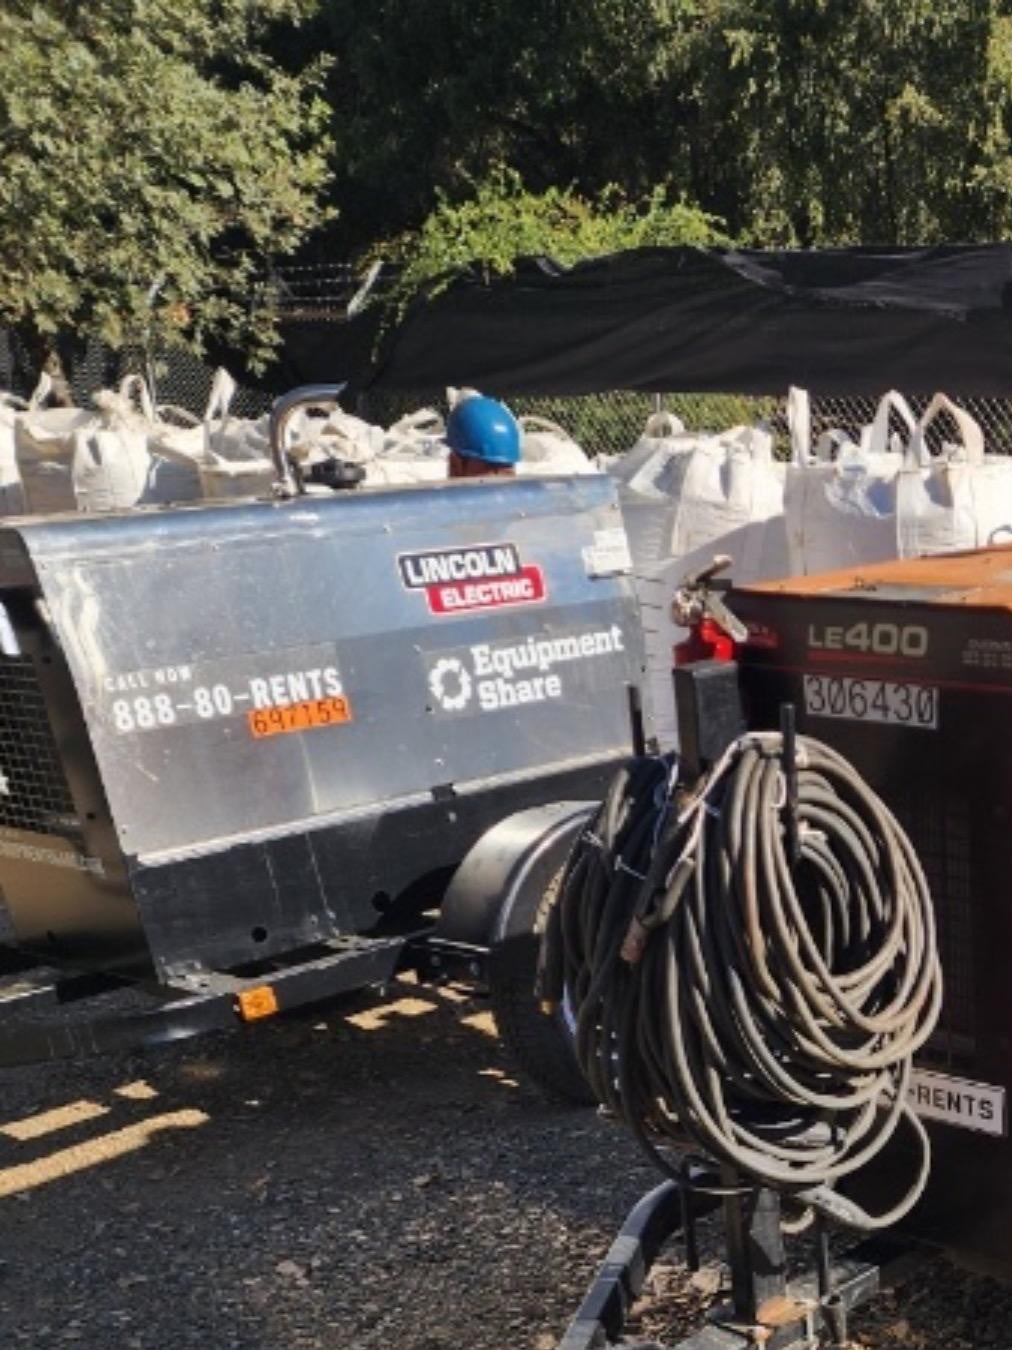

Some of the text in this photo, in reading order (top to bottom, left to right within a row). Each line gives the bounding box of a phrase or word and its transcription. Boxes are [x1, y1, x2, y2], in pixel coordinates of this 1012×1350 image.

[404, 549, 516, 584] LINCOLN
[440, 578, 535, 608] ELECTRIC
[471, 626, 625, 678] Equipment
[808, 623, 928, 657] LE400
[103, 665, 192, 692] CALL NOW
[477, 674, 563, 710] Share
[112, 667, 344, 731] 888-80-RENTS
[808, 674, 935, 723] 306430
